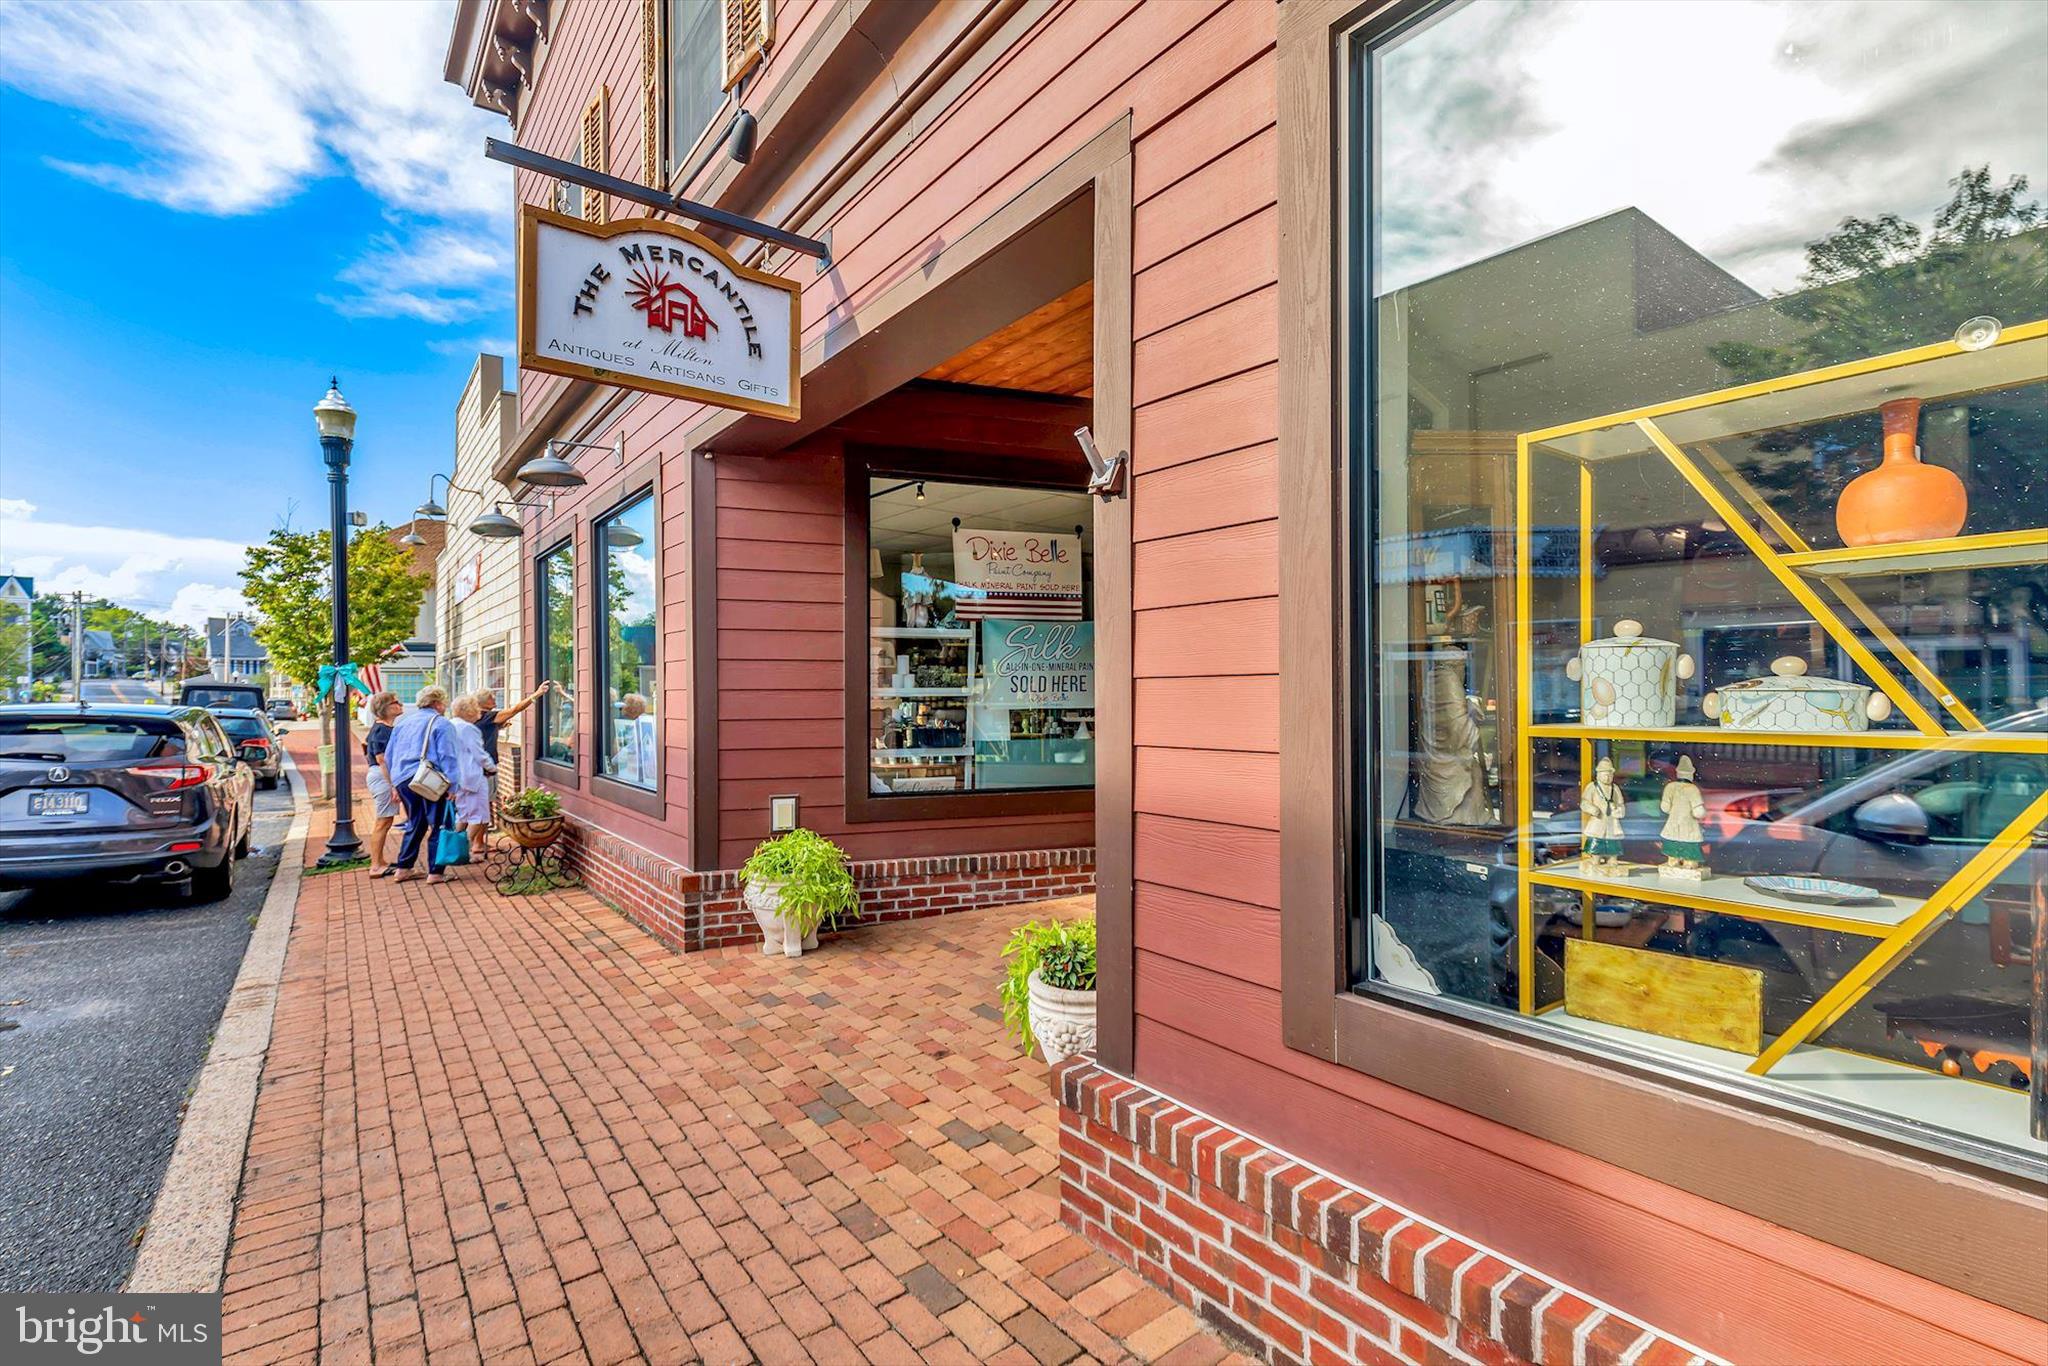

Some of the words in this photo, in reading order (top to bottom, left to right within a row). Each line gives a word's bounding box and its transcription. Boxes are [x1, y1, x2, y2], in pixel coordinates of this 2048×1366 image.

[573, 263, 611, 316] THE
[618, 243, 763, 361] MERCANTILE
[622, 337, 643, 350] at
[651, 338, 713, 366] Milton
[966, 536, 1018, 561] Dixie
[1024, 538, 1069, 563] Belle
[986, 561, 1010, 576] Paint
[1011, 563, 1053, 582] Company
[981, 581, 1013, 590] MINERAL
[1039, 584, 1060, 592] SOLD
[997, 624, 1080, 678] Silk
[1010, 675, 1047, 693] SOLD
[1051, 675, 1087, 692] HERE
